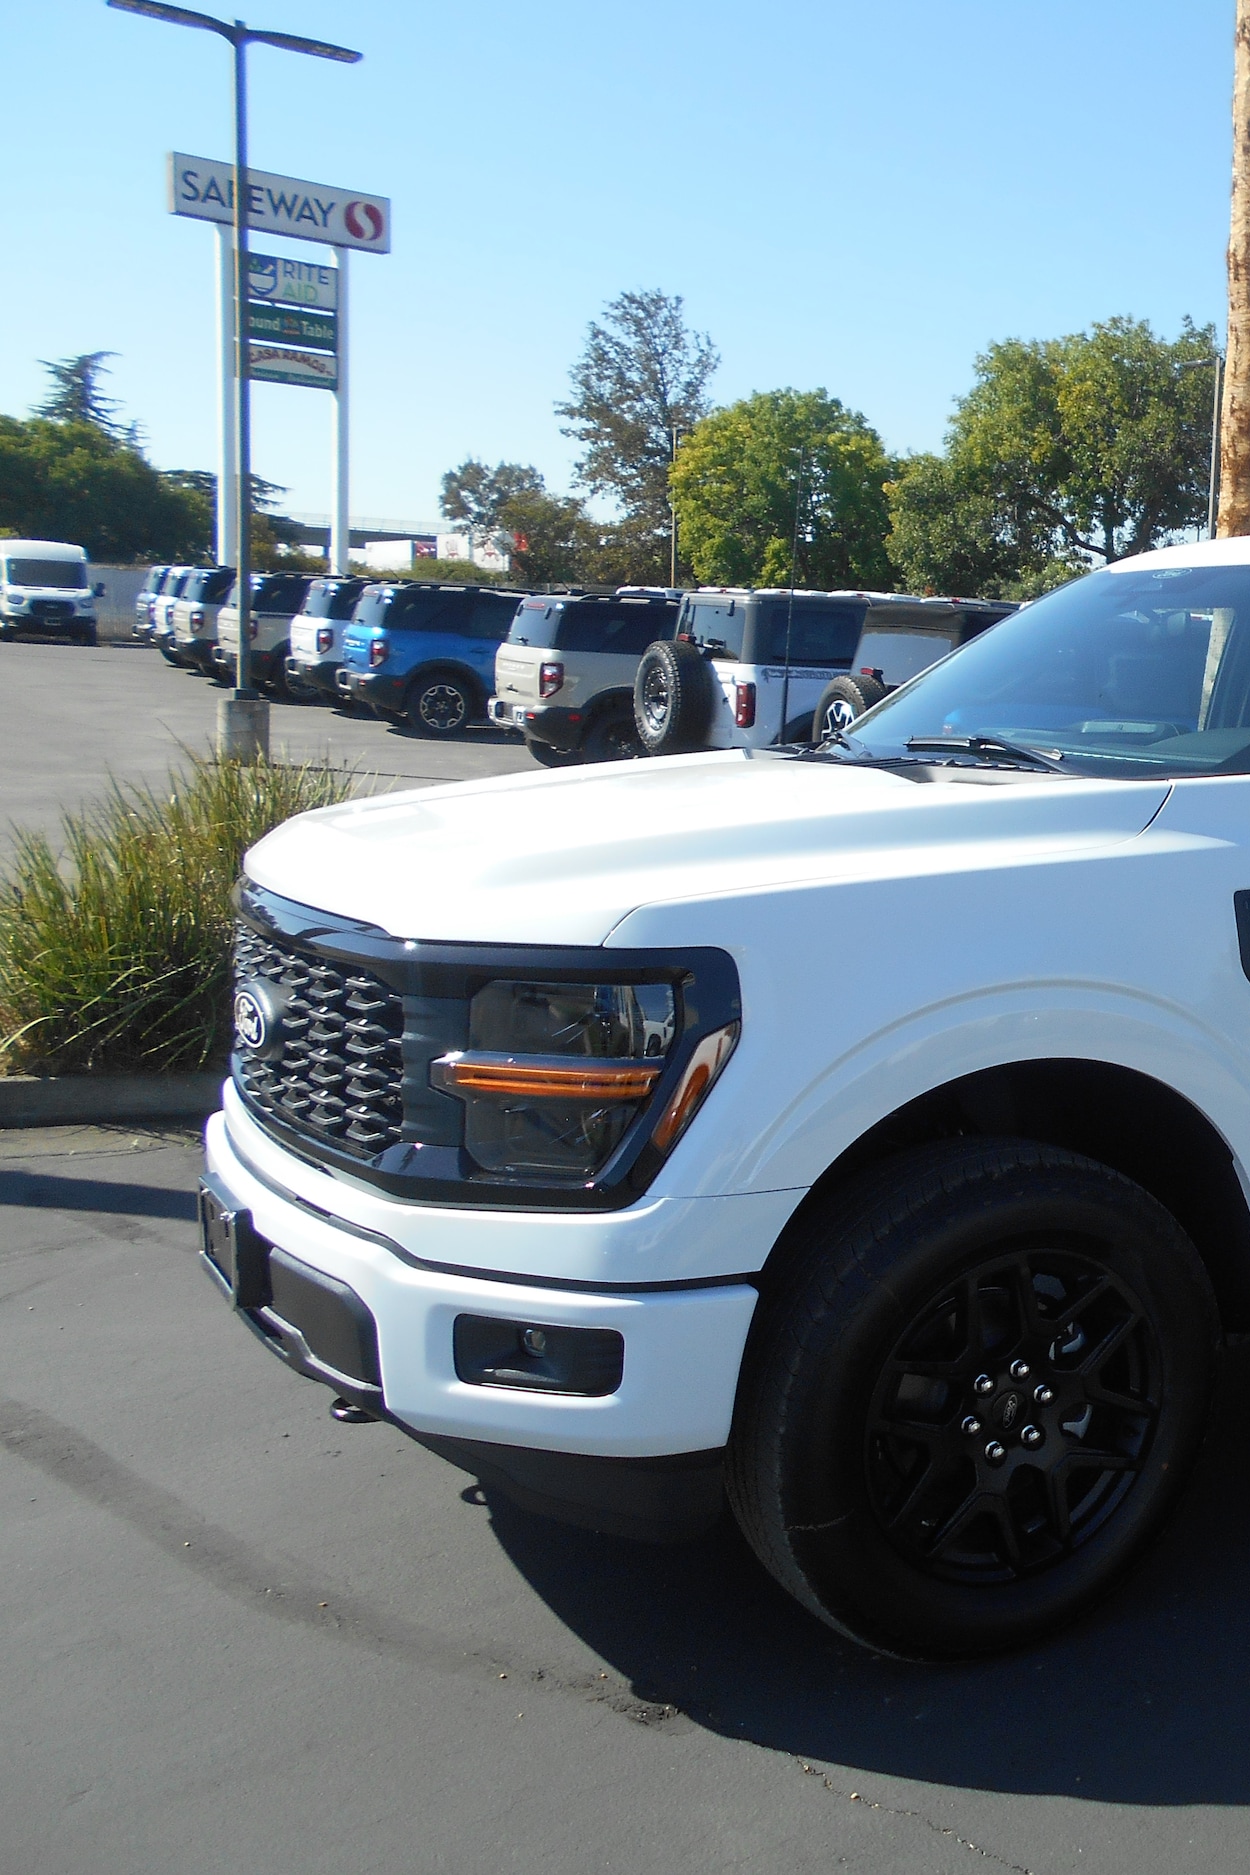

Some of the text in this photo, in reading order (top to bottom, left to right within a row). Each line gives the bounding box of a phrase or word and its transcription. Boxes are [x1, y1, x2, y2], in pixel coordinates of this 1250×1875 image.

[283, 259, 329, 285] RITE
[283, 282, 318, 304] AID
[248, 316, 281, 331] ound
[301, 320, 334, 339] Table
[237, 996, 260, 1043] Ford
